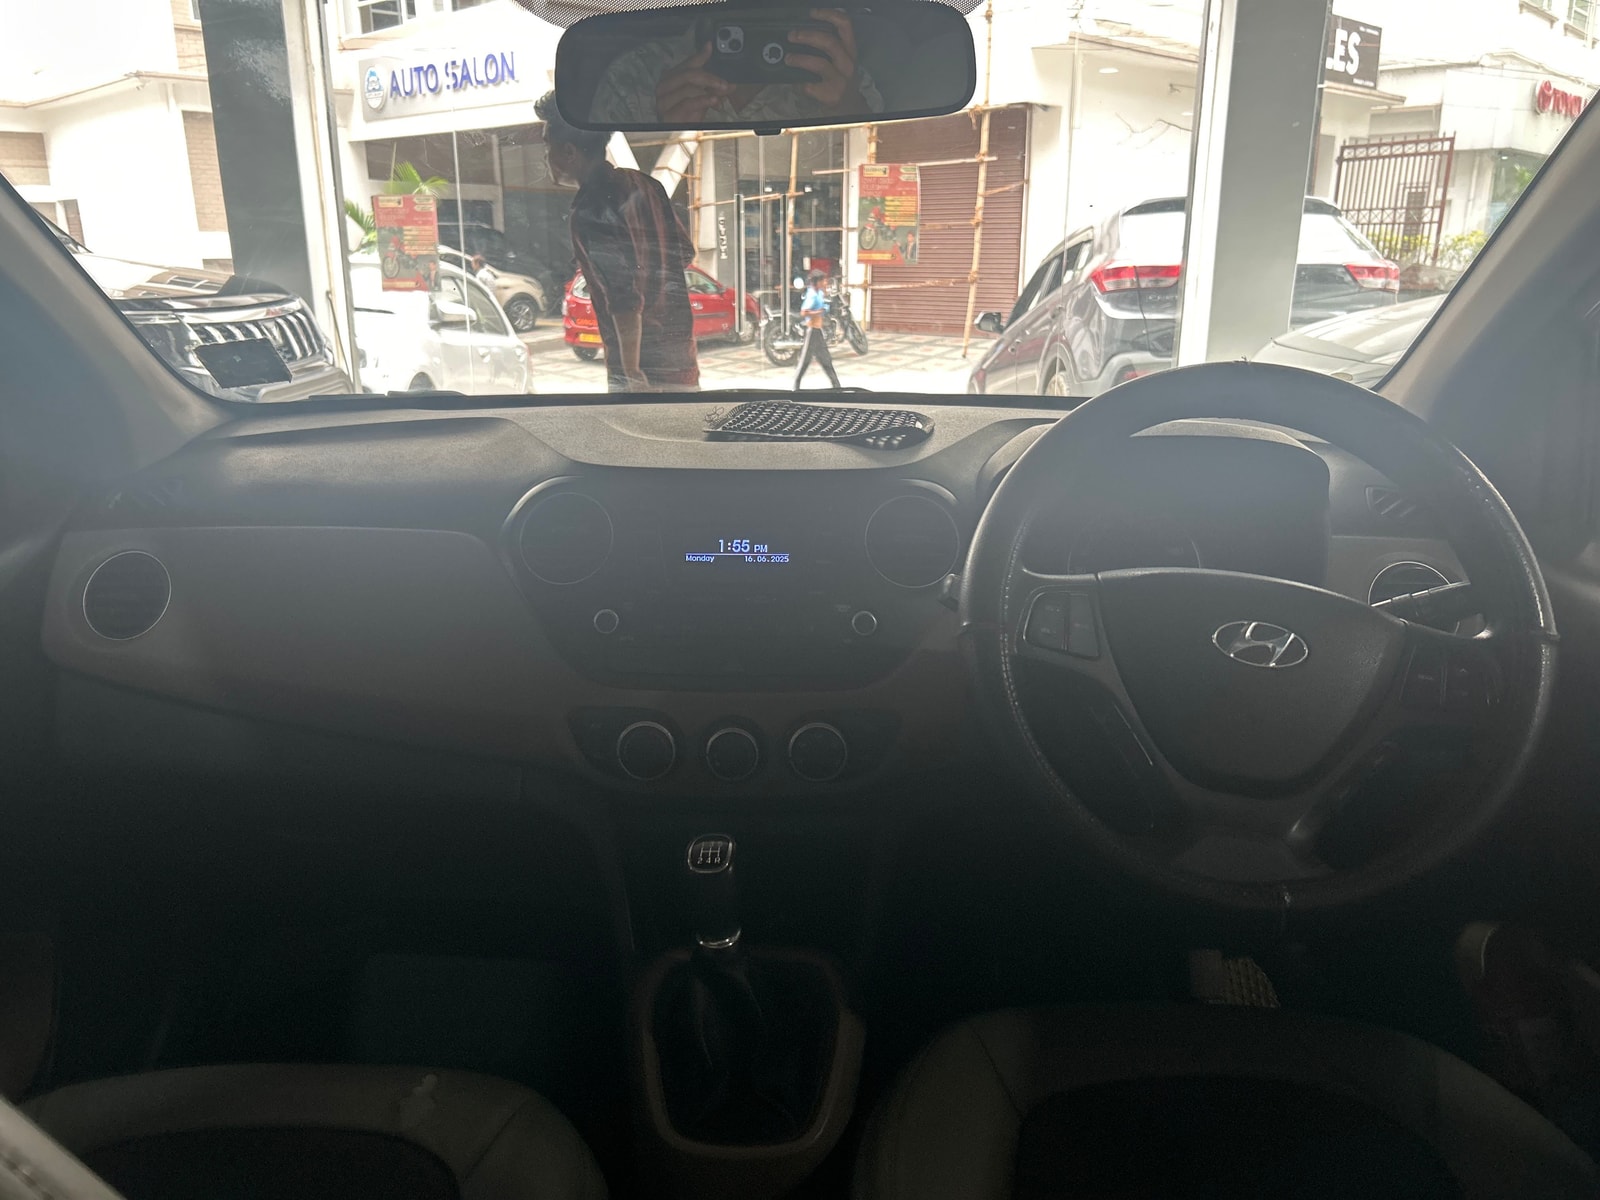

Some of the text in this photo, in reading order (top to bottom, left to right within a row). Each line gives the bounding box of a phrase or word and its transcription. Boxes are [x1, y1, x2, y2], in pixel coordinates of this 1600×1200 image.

[390, 52, 515, 98] AUTO SALON
[719, 539, 768, 553] 1:55 PM
[686, 555, 789, 563] Monday 16.06.2025
[714, 856, 721, 864] R
